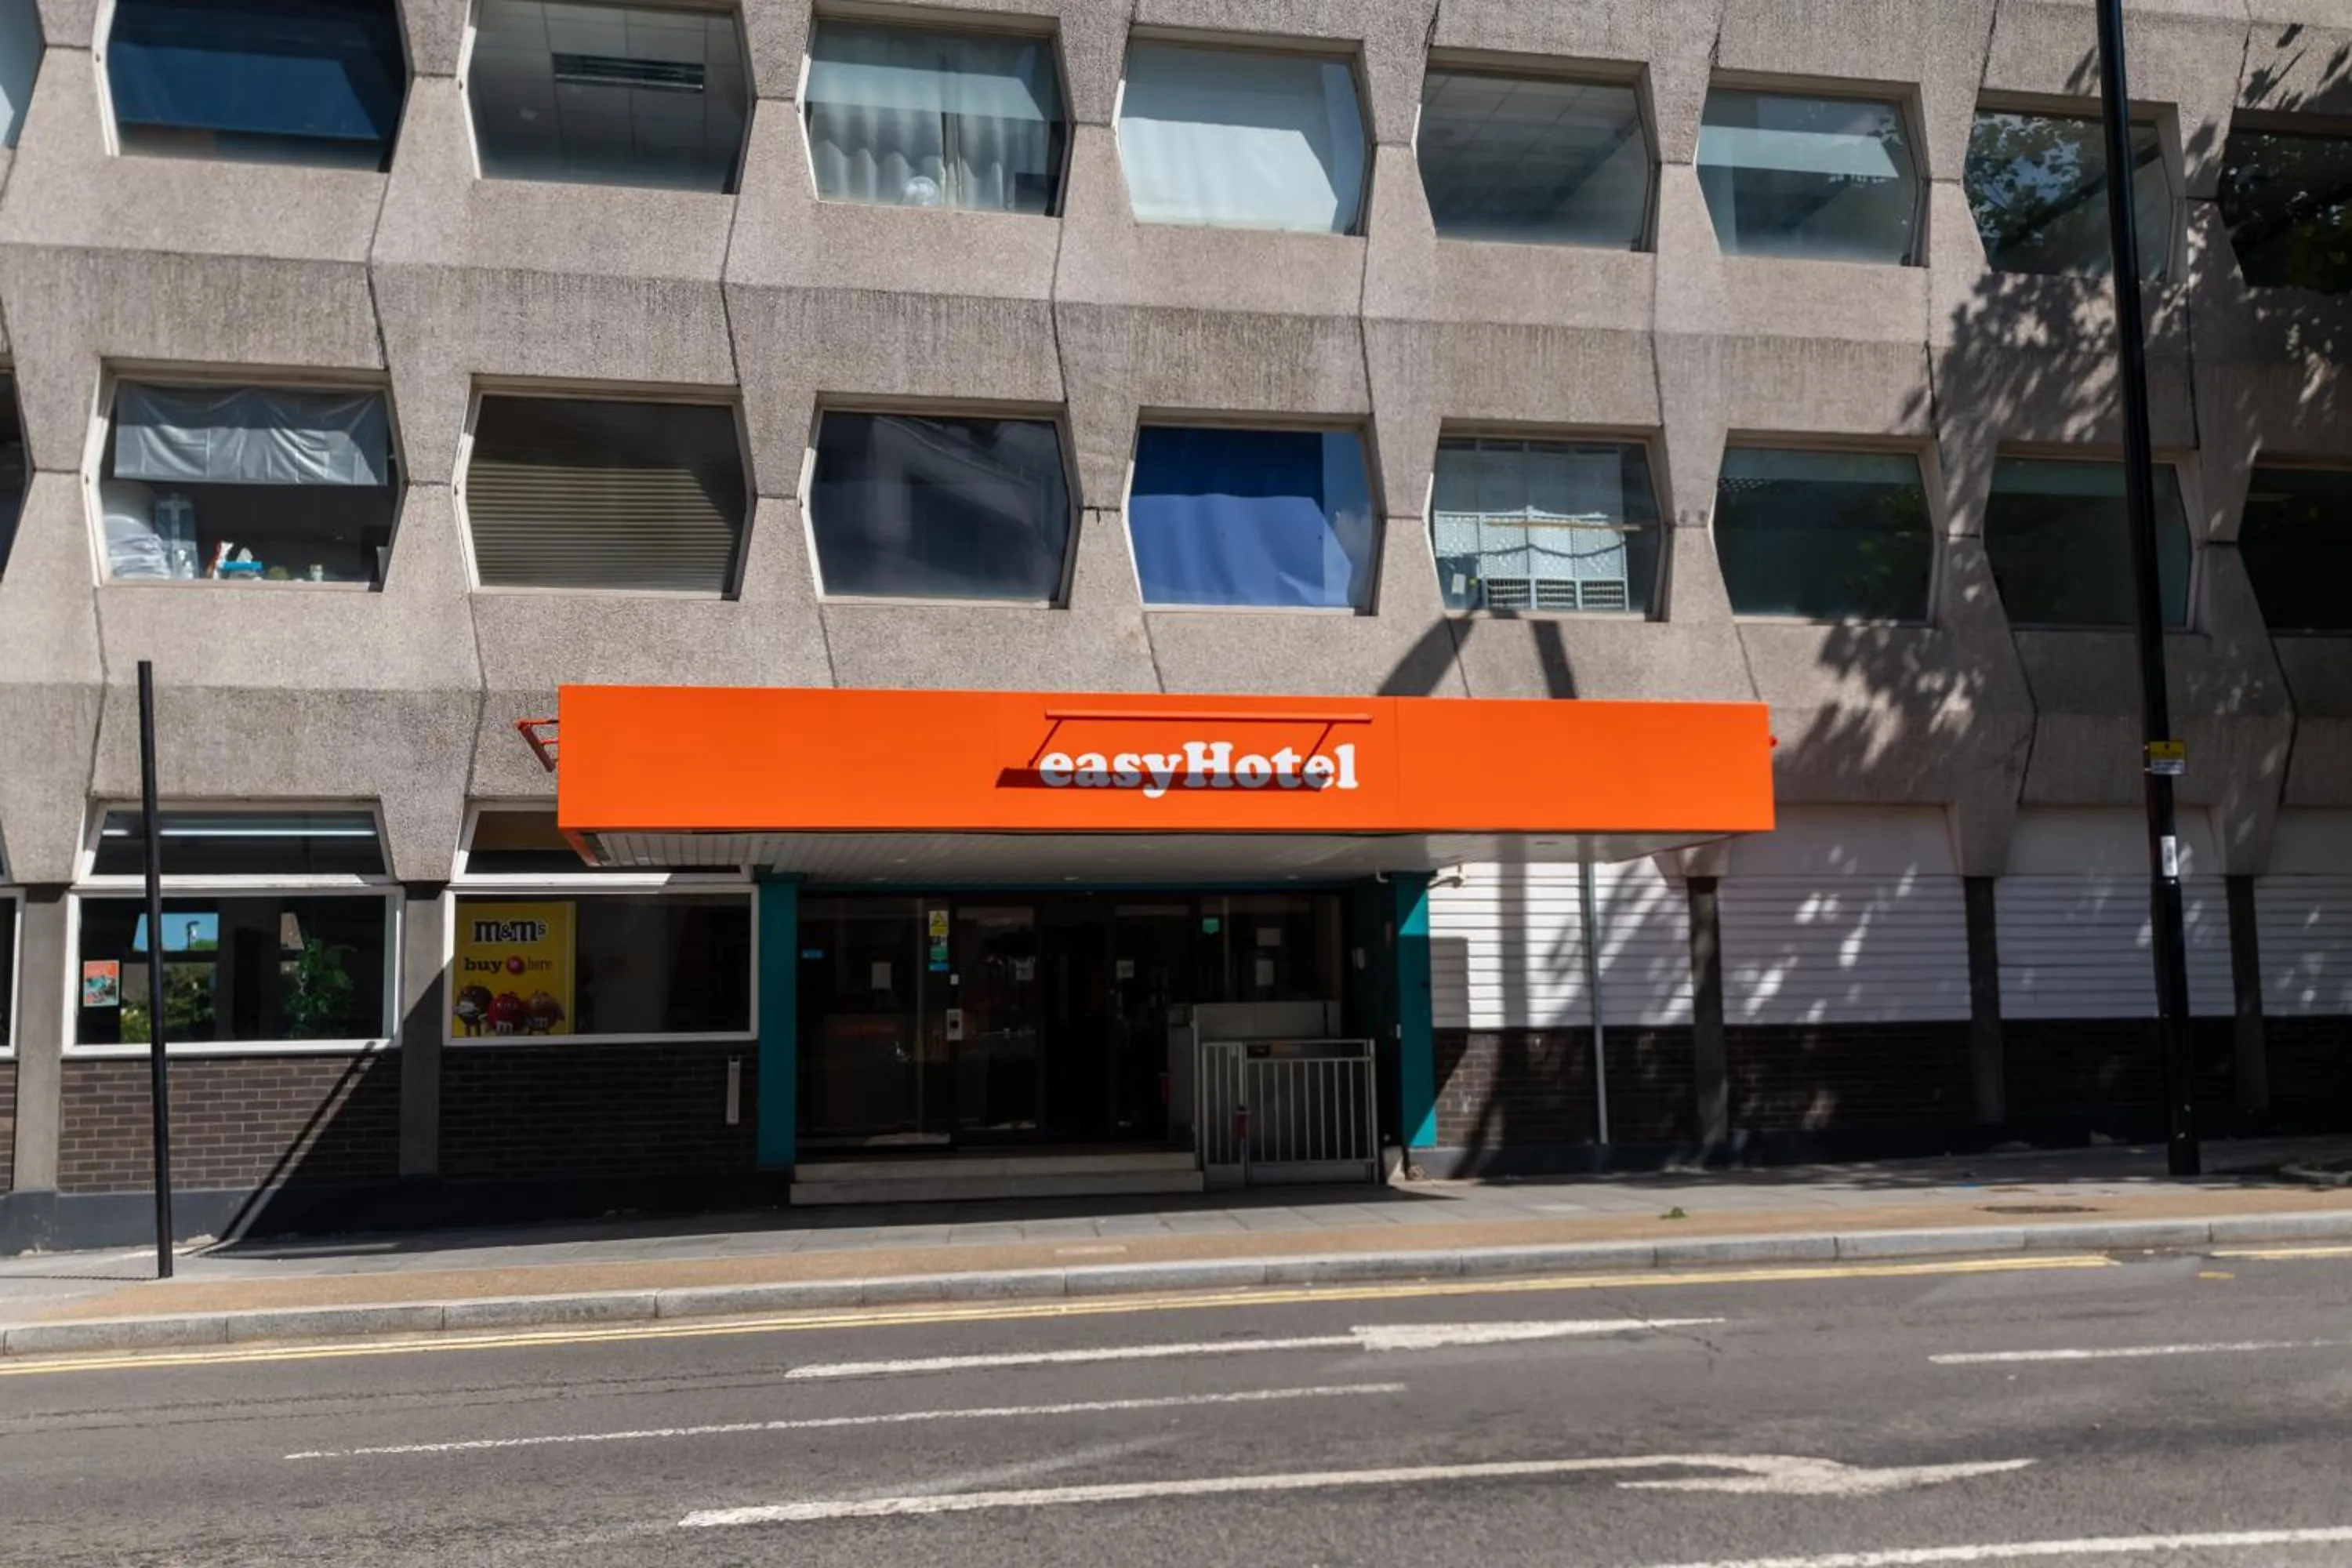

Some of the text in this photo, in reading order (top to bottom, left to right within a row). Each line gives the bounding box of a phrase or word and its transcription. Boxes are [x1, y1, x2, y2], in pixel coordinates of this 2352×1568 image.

[1039, 741, 1359, 798] easyHotel
[464, 956, 553, 974] buy here
